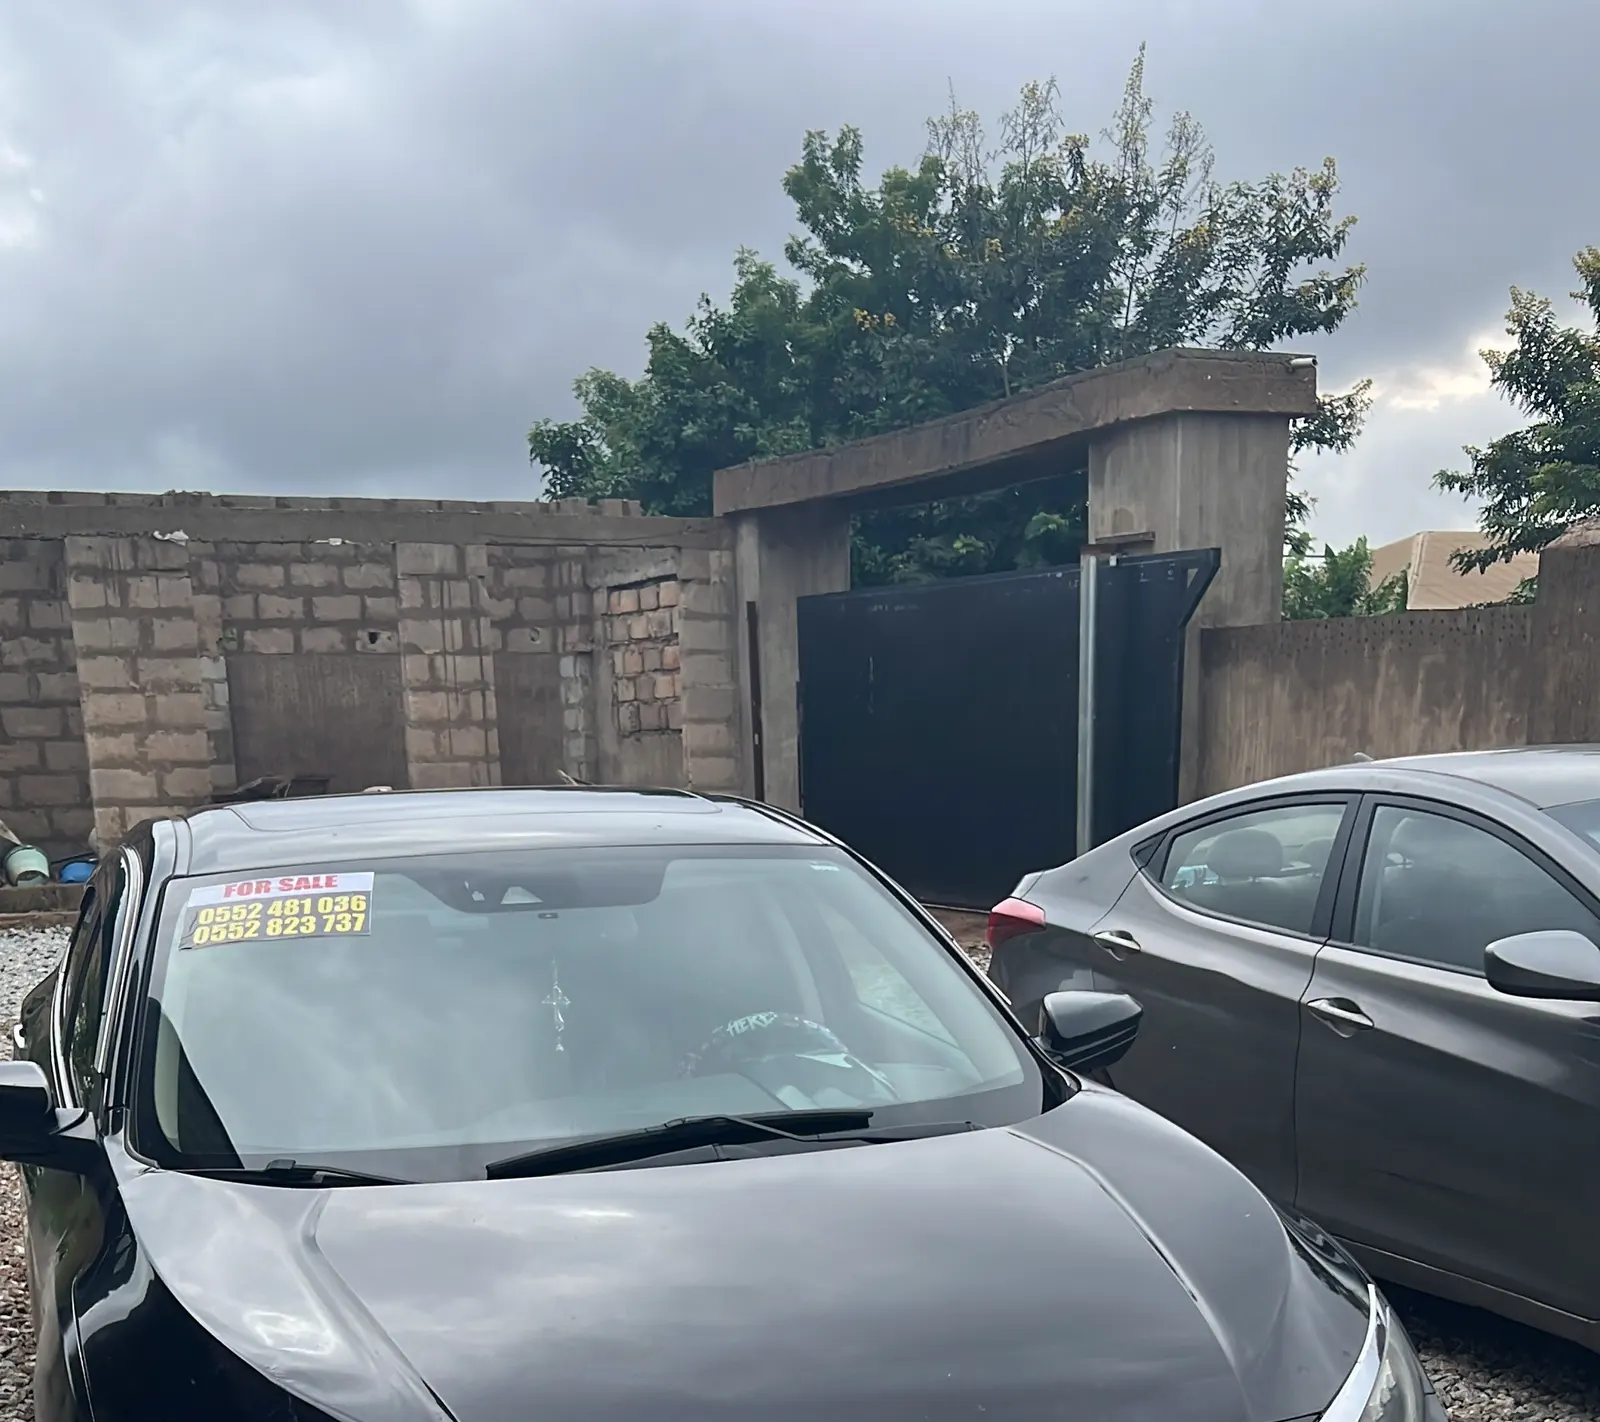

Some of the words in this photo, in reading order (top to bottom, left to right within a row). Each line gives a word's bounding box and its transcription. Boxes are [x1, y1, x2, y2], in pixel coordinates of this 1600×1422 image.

[223, 880, 271, 898] FOR
[278, 874, 339, 892] SALE
[198, 902, 263, 925] 0552
[266, 897, 312, 917] 481
[317, 894, 367, 914] 036
[192, 920, 261, 945] 0552
[266, 914, 316, 937] 823
[322, 913, 366, 933] 737
